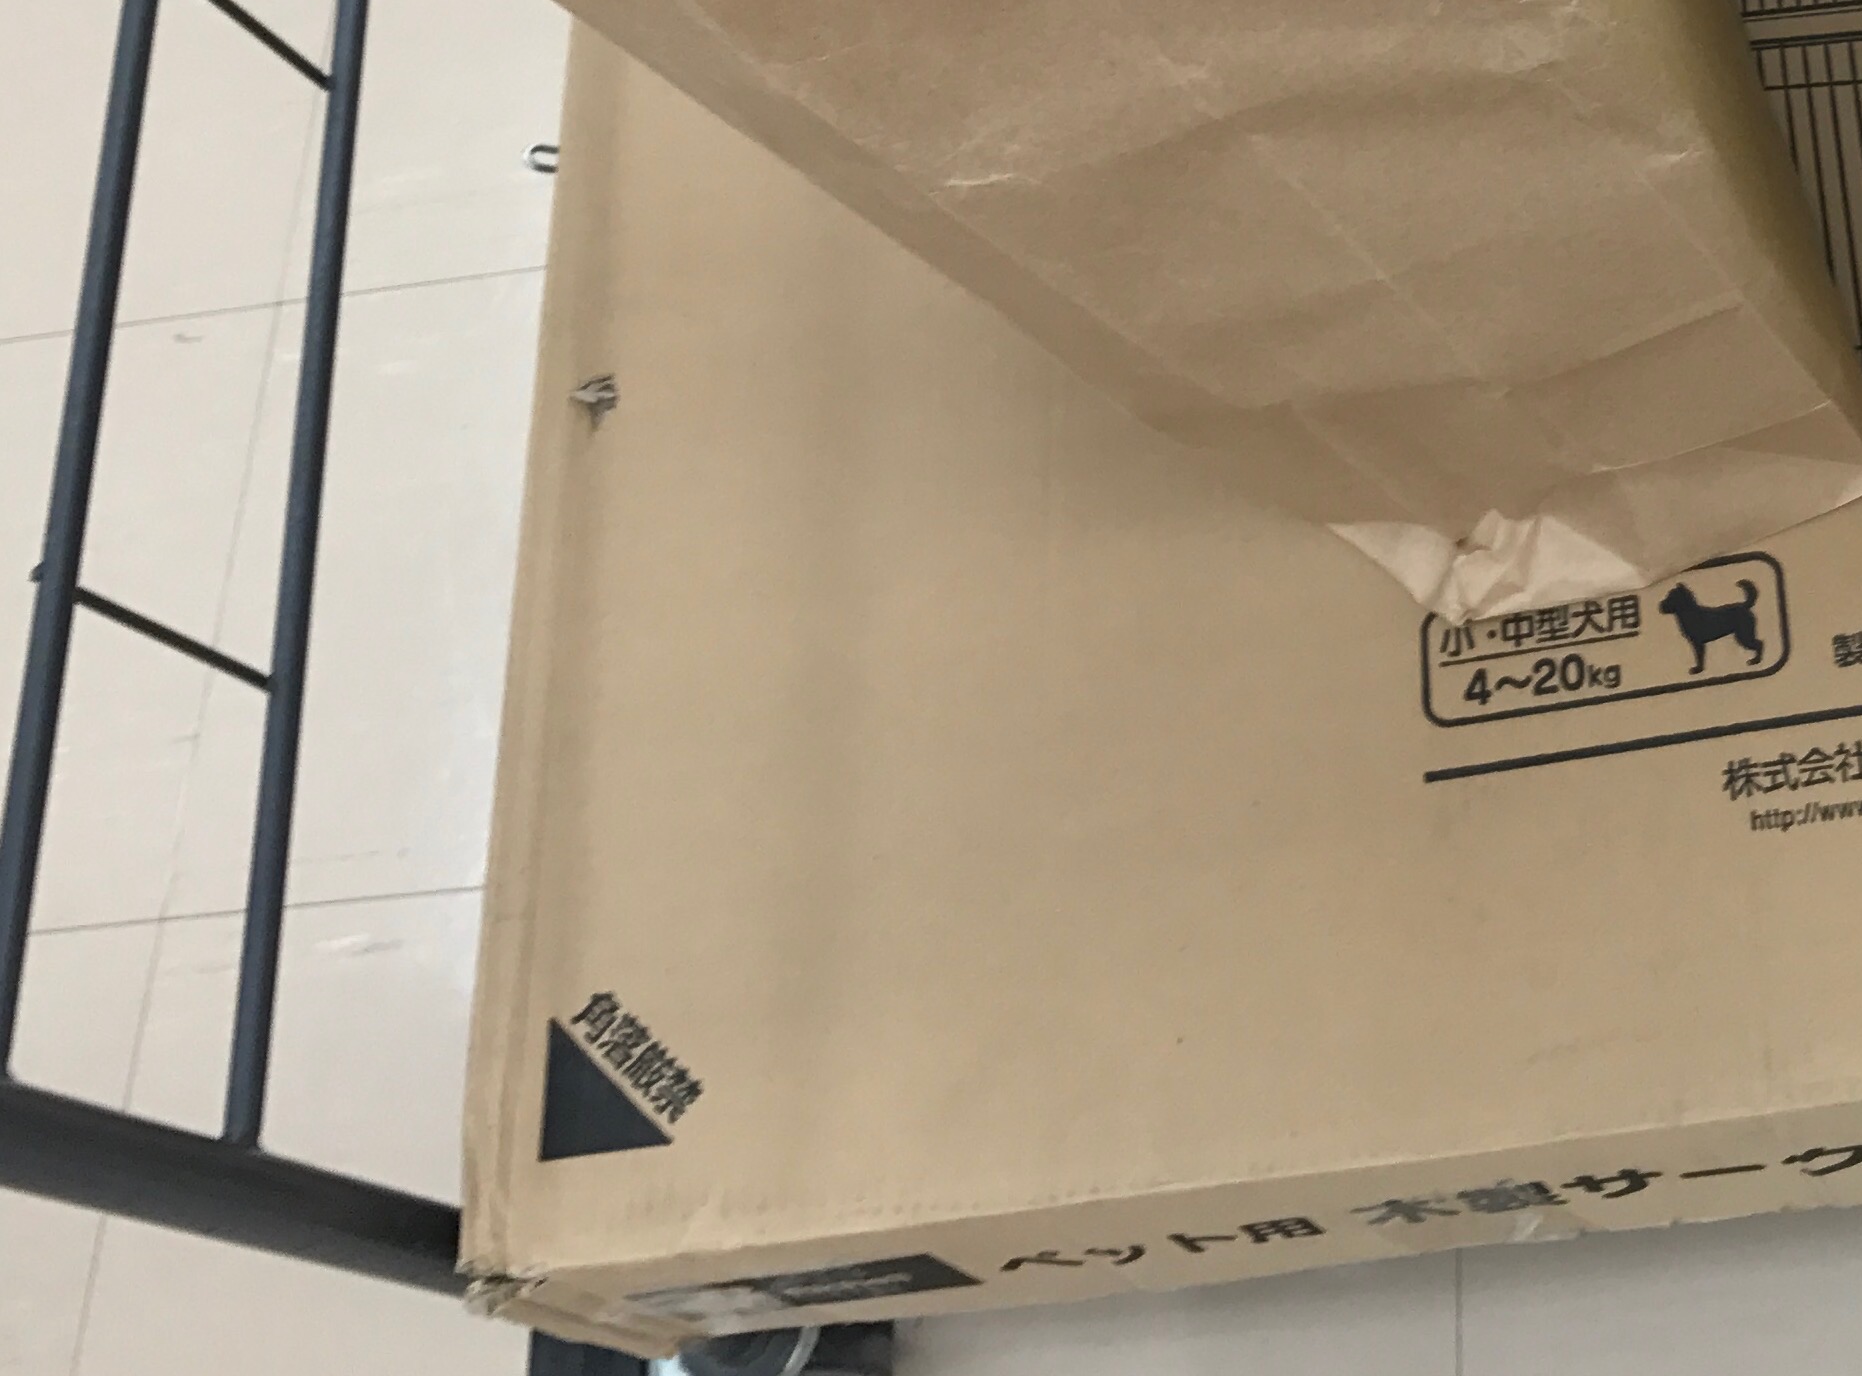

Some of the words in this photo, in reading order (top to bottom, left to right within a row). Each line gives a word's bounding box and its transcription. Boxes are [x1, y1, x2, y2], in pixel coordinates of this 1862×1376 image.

[1439, 594, 1642, 658] 小・中型犬用
